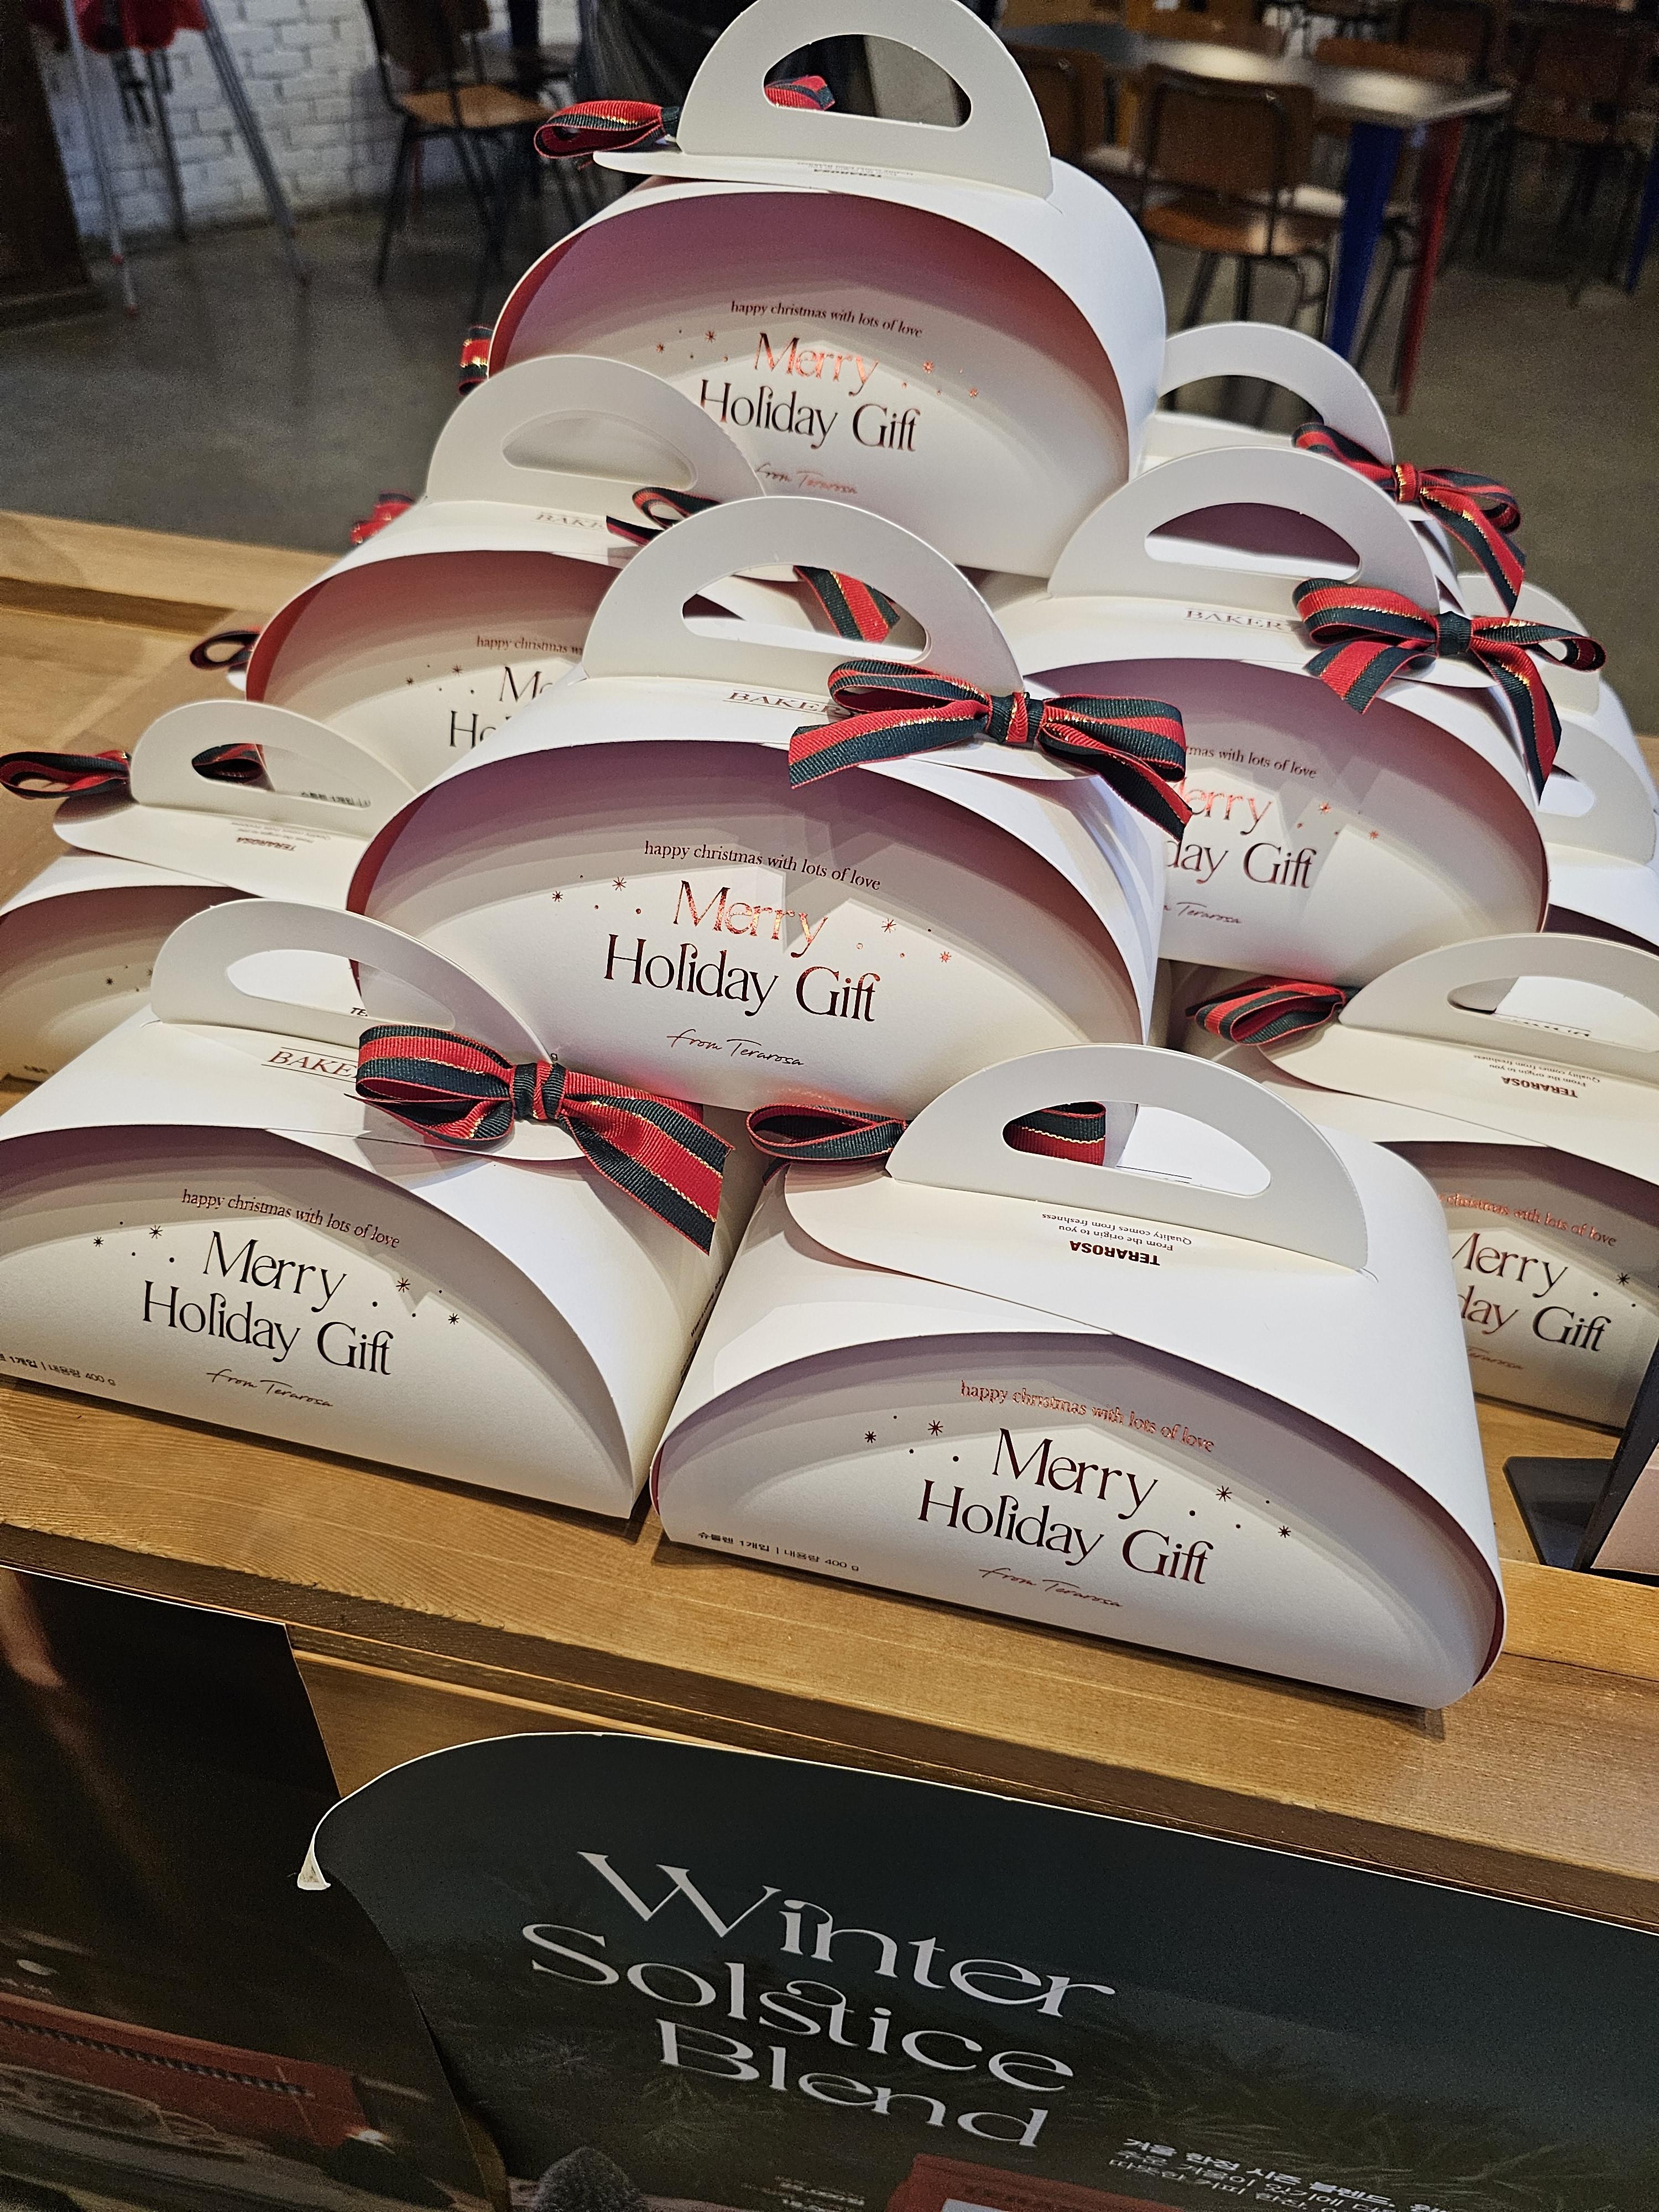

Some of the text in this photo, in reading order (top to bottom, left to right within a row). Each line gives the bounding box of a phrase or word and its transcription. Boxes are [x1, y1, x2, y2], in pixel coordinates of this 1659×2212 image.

[731, 301, 922, 338] happy christmas with lots of love
[754, 332, 879, 397] Merry
[700, 379, 921, 452] Holiday Gift
[1187, 611, 1294, 632] BAKER
[476, 635, 512, 650] happy
[515, 637, 567, 654] christmas
[1219, 749, 1244, 763] with
[1248, 753, 1270, 768] lots
[1274, 760, 1290, 772] of
[1290, 761, 1317, 779] love
[645, 841, 880, 890] happy christmas with lots of love
[1243, 842, 1317, 889] Gift
[673, 880, 828, 958] Merry
[1177, 902, 1241, 924] Terarosa
[604, 933, 881, 1022] Holiday Gift
[267, 1051, 358, 1078] BAKE
[667, 1029, 805, 1066] from Terarosa
[1515, 1061, 1536, 1070] from
[1501, 1076, 1578, 1098] TERAROSA
[1563, 1078, 1586, 1087] From
[1568, 1071, 1600, 1084] Quality
[181, 1189, 400, 1248] happy christmas with lots of love
[1042, 1214, 1192, 1245] Quality comes from freshness
[1058, 1225, 1077, 1233] you
[1094, 1231, 1124, 1241] origin
[1514, 1208, 1541, 1224] with
[1545, 1212, 1567, 1230] lots
[1571, 1223, 1588, 1237] of
[1589, 1226, 1617, 1246] love
[1070, 1240, 1160, 1266] TERAROSA
[1127, 1236, 1142, 1245] the
[1146, 1240, 1173, 1251] From
[203, 1231, 347, 1312] Merry
[143, 1281, 393, 1375] Holiday Gift
[1532, 1306, 1611, 1352] Gift
[85, 1373, 105, 1383] 400
[206, 1368, 333, 1407] from Terarosa
[961, 1380, 1215, 1453] happy christmas with lots of love
[992, 1427, 1159, 1520] Merry
[917, 1479, 1214, 1584] Holiday Gift
[739, 1540, 770, 1552] 1개입
[784, 1549, 820, 1563] 내용량
[825, 1558, 847, 1568] 400
[978, 1567, 1123, 1608] from Terarosa
[576, 1850, 1116, 2018] Winter
[521, 1923, 1074, 2093] Solstice
[655, 2019, 1049, 2148] Blend
[1109, 2159, 1187, 2181] 따뜻한
[1194, 2178, 1246, 2195] 커피
[1123, 2138, 1177, 2157] 겨울
[1186, 2152, 1240, 2171] 한정
[1245, 2168, 1302, 2185] 시즌
[1176, 2163, 1256, 2187] 겨울이
[1265, 2183, 1345, 2206] 있기에
